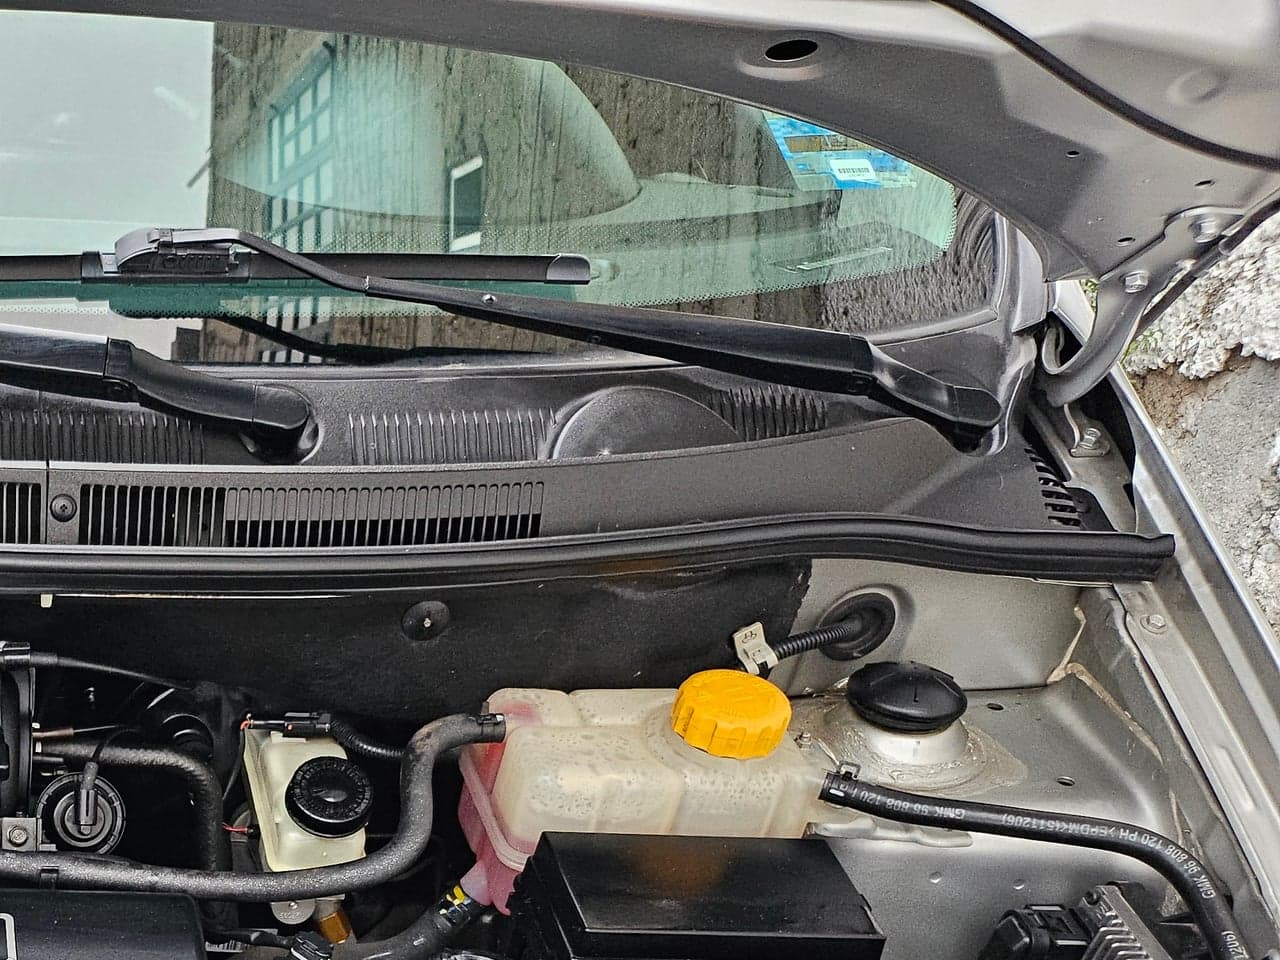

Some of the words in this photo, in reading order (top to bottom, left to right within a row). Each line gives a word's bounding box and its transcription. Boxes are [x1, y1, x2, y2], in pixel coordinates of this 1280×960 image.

[1120, 829, 1138, 842] PH
[1140, 833, 1164, 850] 120
[1166, 844, 1188, 864] 808
[1194, 873, 1216, 899] GMK
